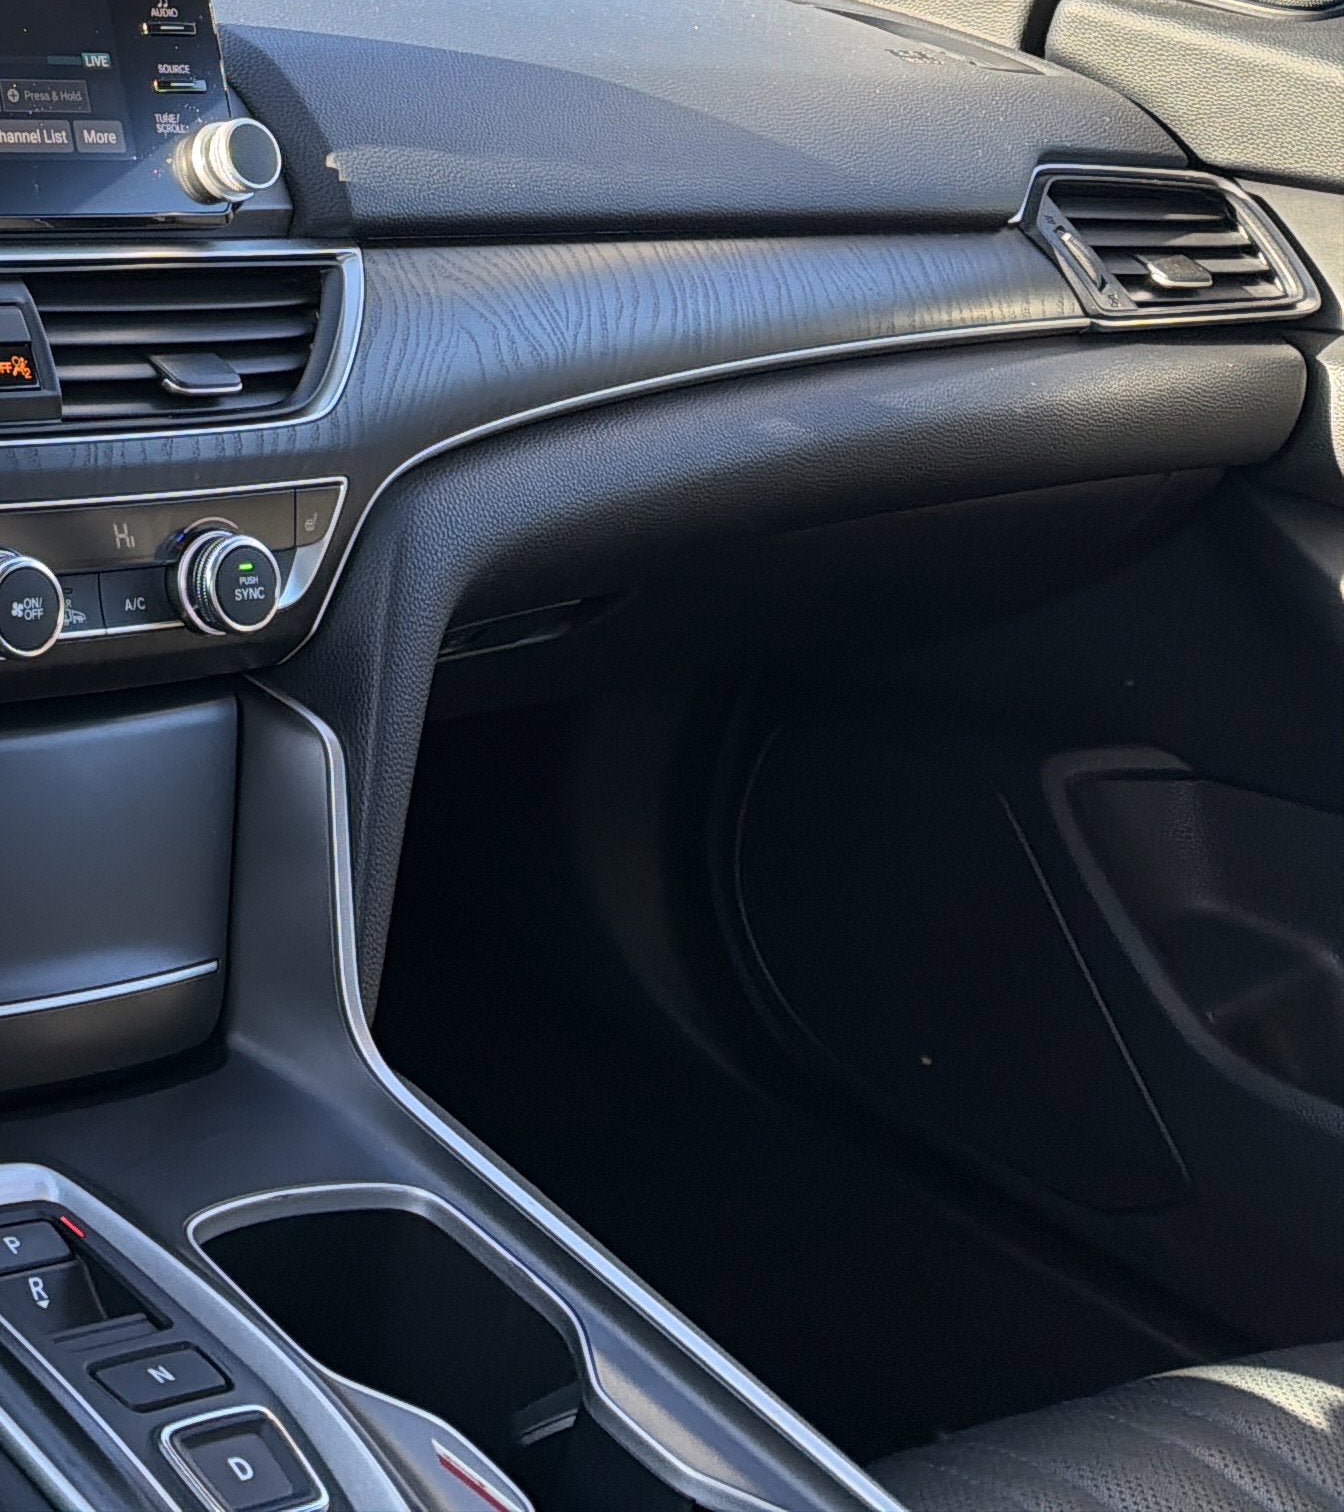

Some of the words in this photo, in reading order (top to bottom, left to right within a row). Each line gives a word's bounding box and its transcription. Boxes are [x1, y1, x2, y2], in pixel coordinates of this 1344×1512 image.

[150, 7, 179, 18] AUDIO
[84, 55, 110, 69] LIVE
[157, 63, 191, 75] SOURCE
[24, 90, 50, 102] Press
[61, 90, 83, 102] Hold
[43, 129, 69, 145] List
[83, 129, 117, 145] More
[238, 575, 259, 587] PUSH
[234, 587, 265, 602] SYNC
[23, 596, 43, 610] ON/
[124, 597, 147, 611] A/C
[23, 607, 45, 621] OFF
[2, 1235, 22, 1255] P
[27, 1276, 46, 1303] R
[147, 1364, 176, 1386] N
[227, 1455, 254, 1482] D
